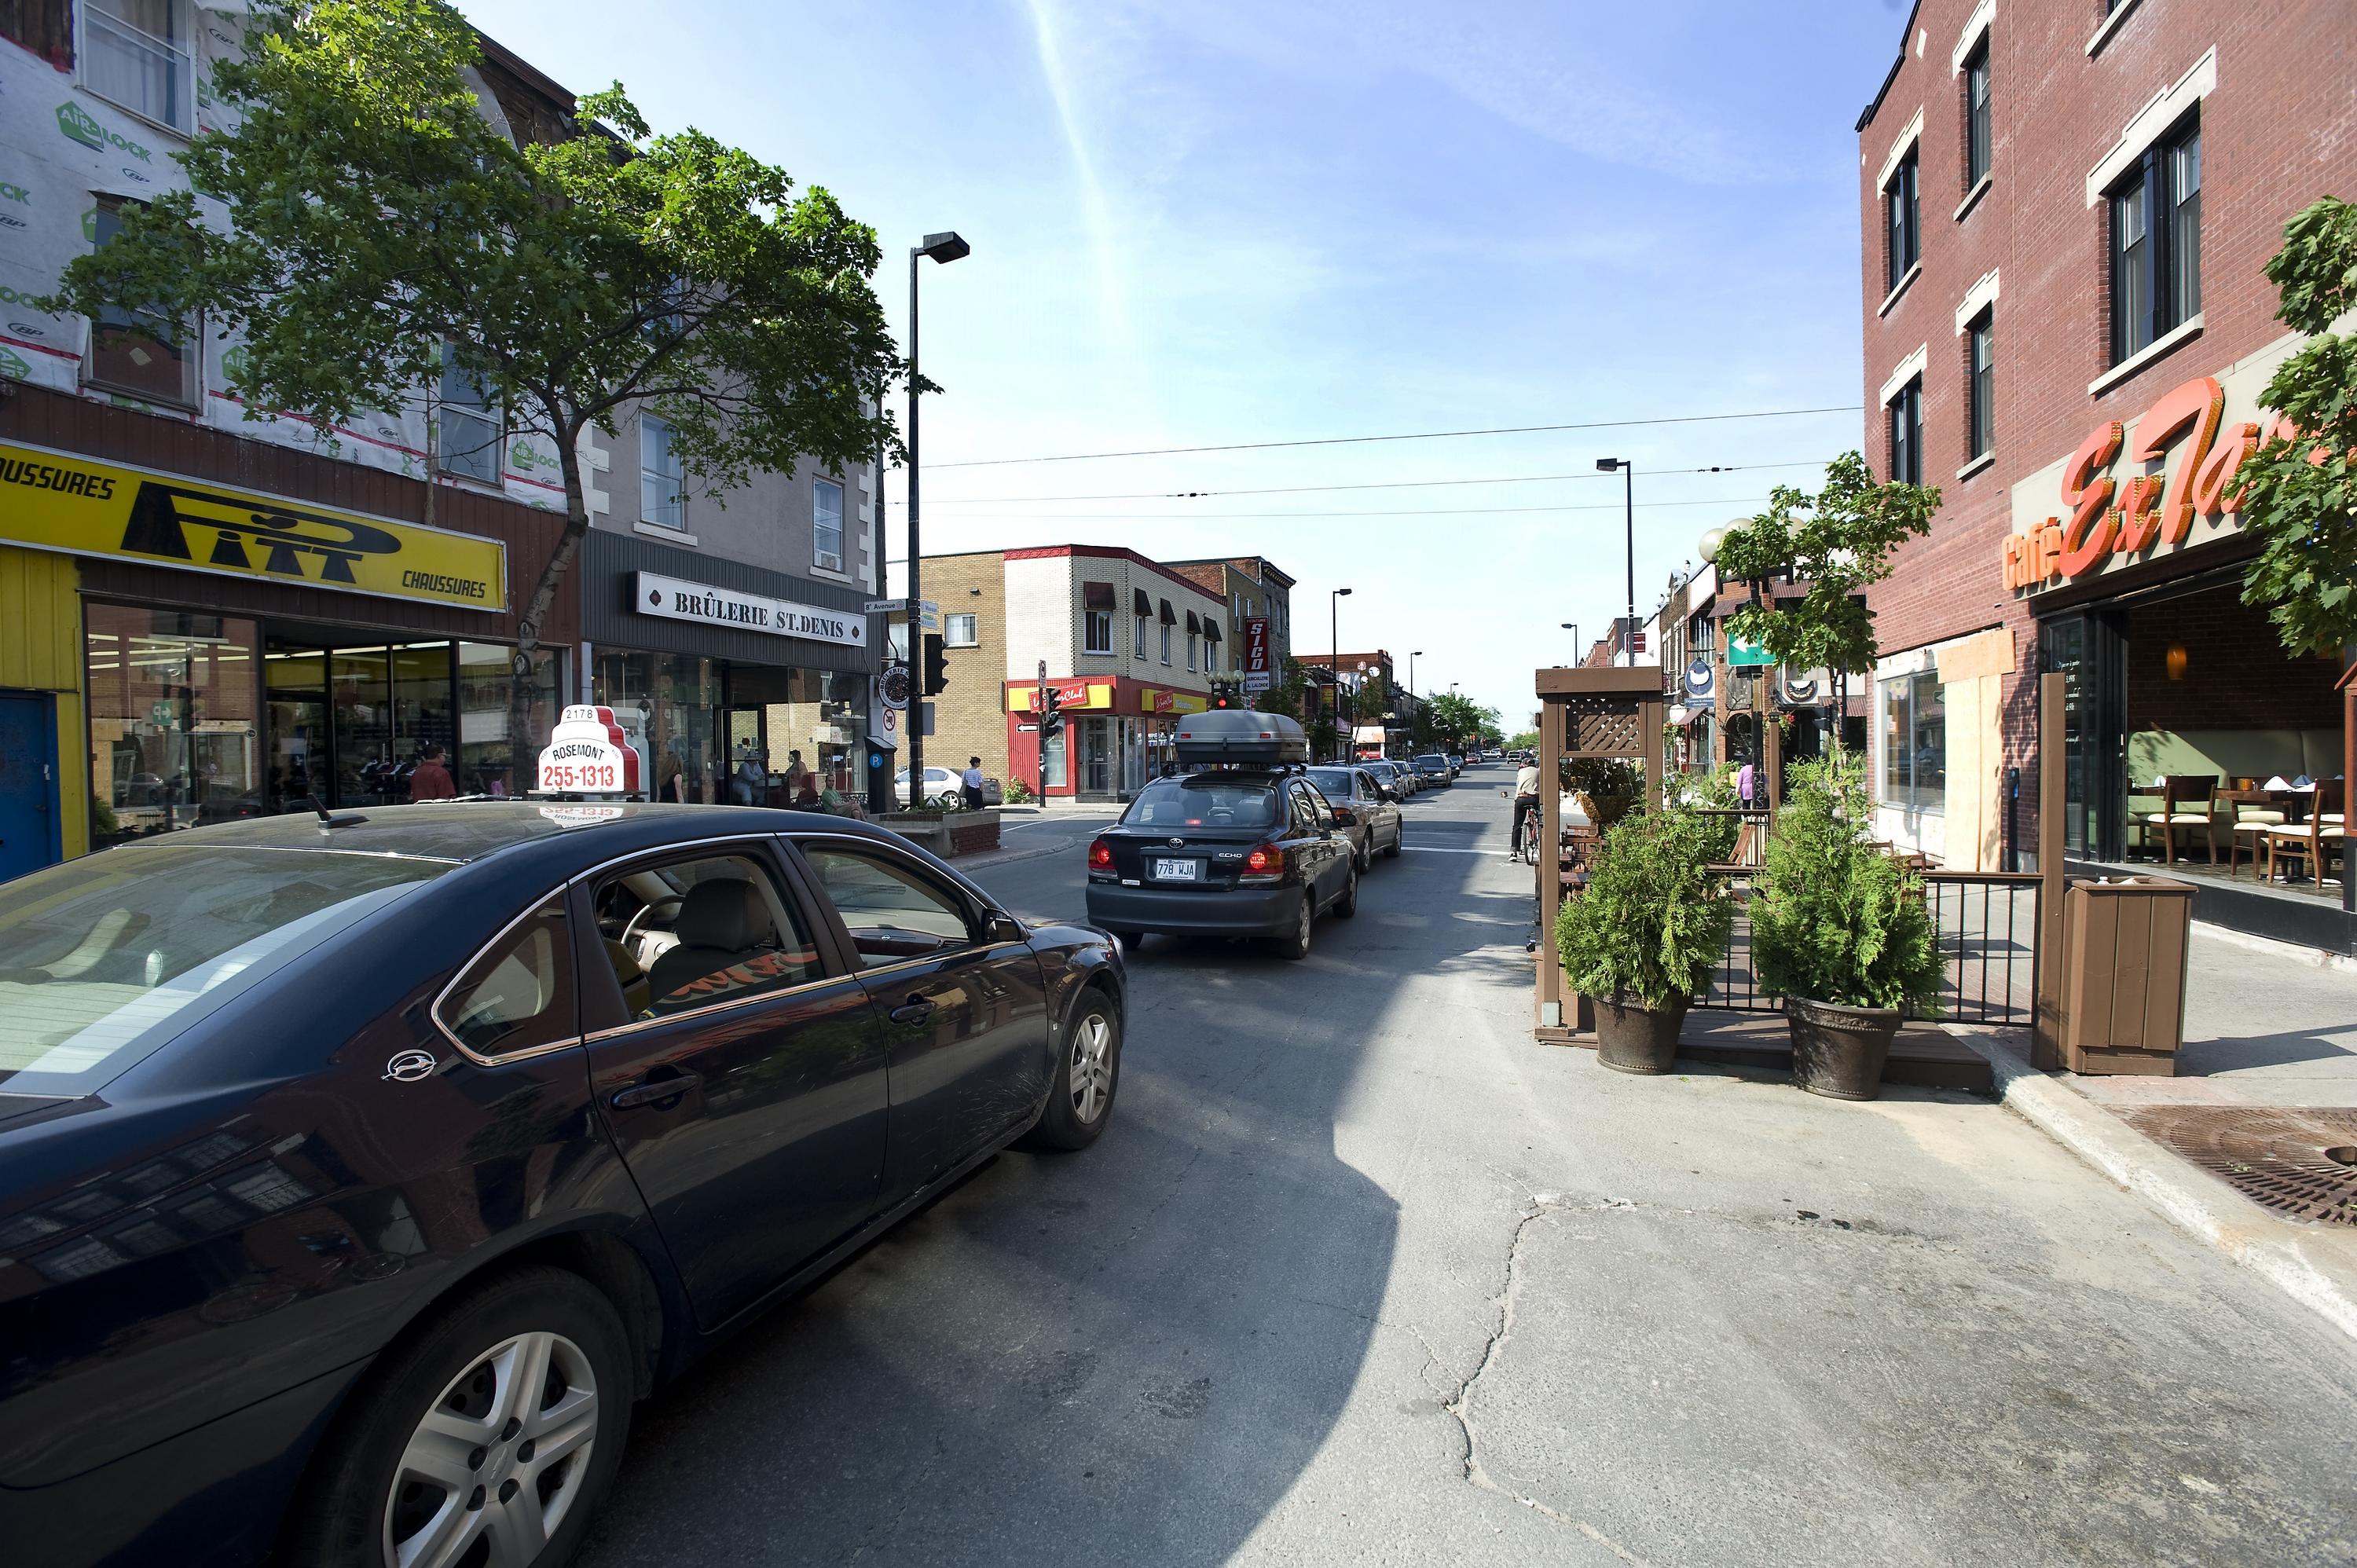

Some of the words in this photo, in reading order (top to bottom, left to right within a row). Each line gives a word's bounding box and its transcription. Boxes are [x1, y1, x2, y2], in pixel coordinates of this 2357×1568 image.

[0, 181, 31, 207] CK
[0, 456, 116, 500] USSURES
[2001, 516, 2063, 591] Café
[401, 570, 486, 599] CHAUSSURES
[674, 591, 768, 627] BRÛLERIE
[1250, 623, 1264, 670] SICO
[566, 709, 593, 719] 2178
[552, 744, 605, 762] ROSEMONT
[544, 765, 614, 787] 255-1313
[1158, 863, 1174, 875] 778
[1178, 865, 1194, 876] WJA
